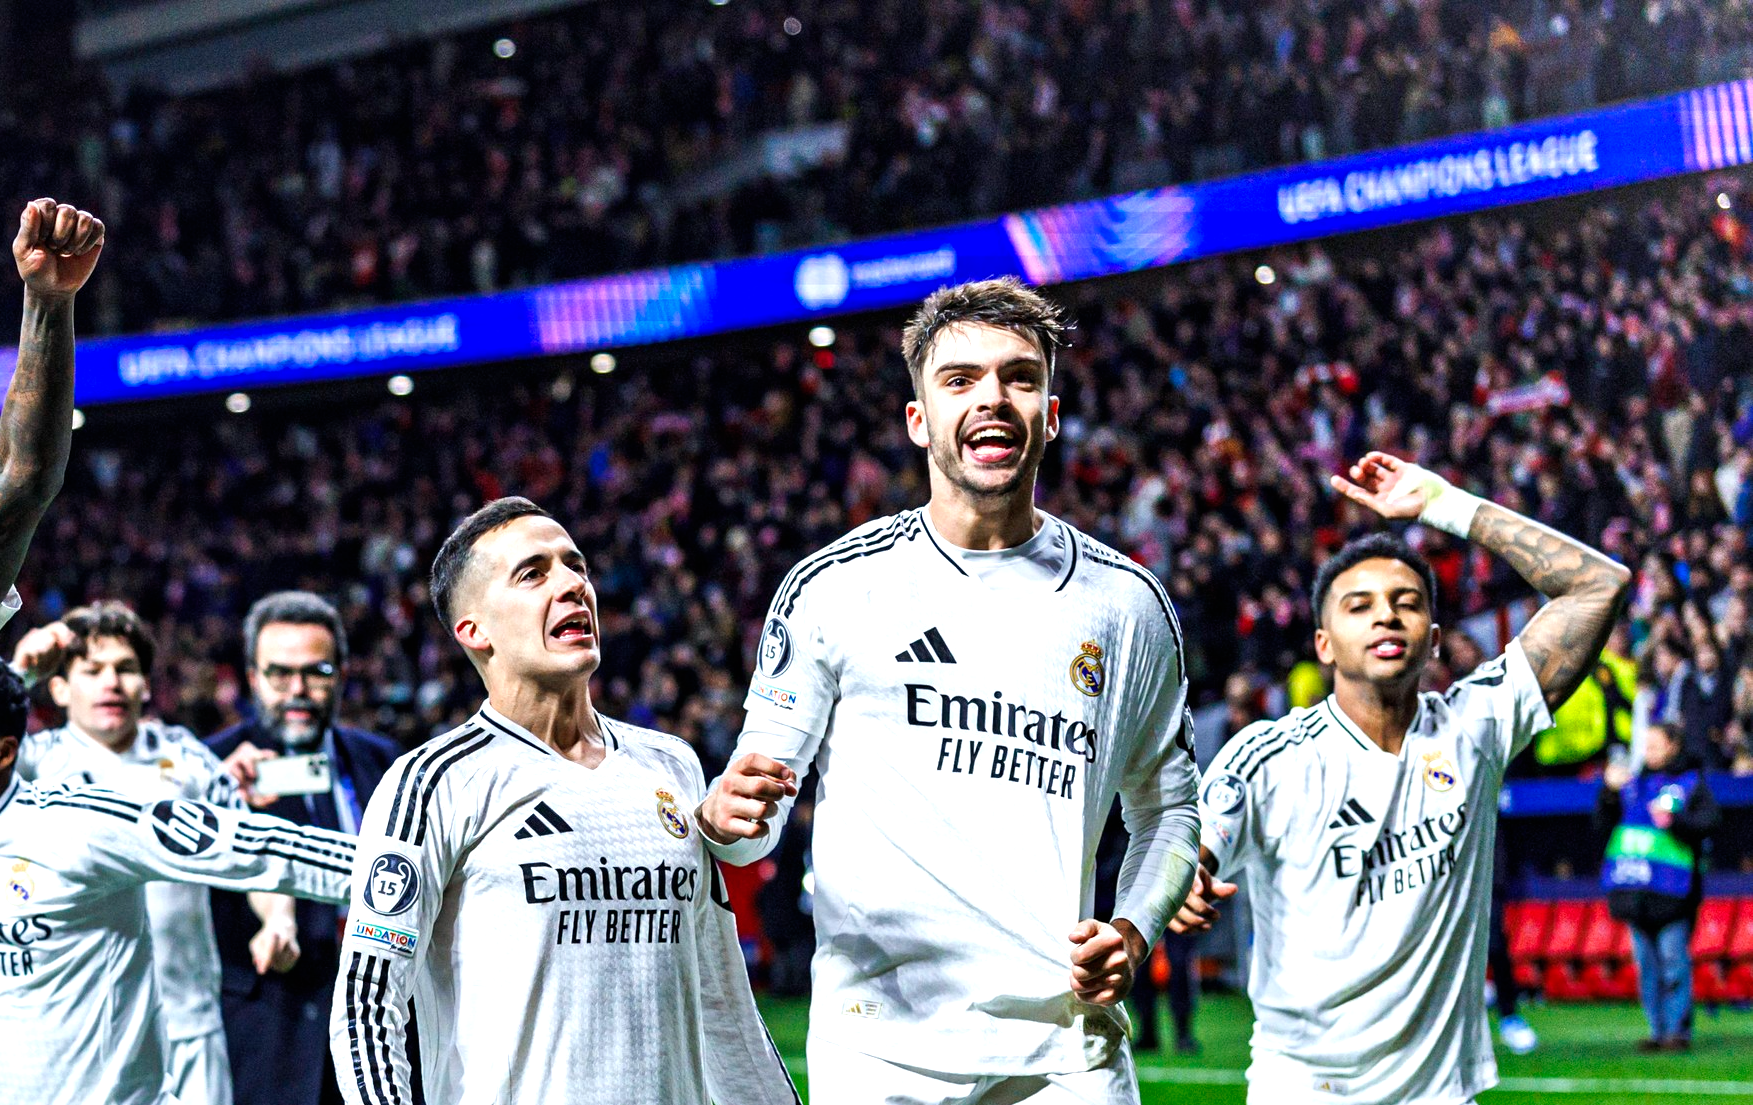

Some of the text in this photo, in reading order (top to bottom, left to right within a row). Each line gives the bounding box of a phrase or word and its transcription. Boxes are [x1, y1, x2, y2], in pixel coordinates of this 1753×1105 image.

[765, 644, 776, 659] 15
[904, 683, 1097, 764] Emirates
[937, 737, 1077, 800] FLY BETTER
[1331, 803, 1467, 880] Emirates
[378, 880, 397, 896] 15
[519, 857, 698, 905] Emirates
[1355, 844, 1457, 907] FLY BETTER
[556, 909, 681, 945] FLY BETTER
